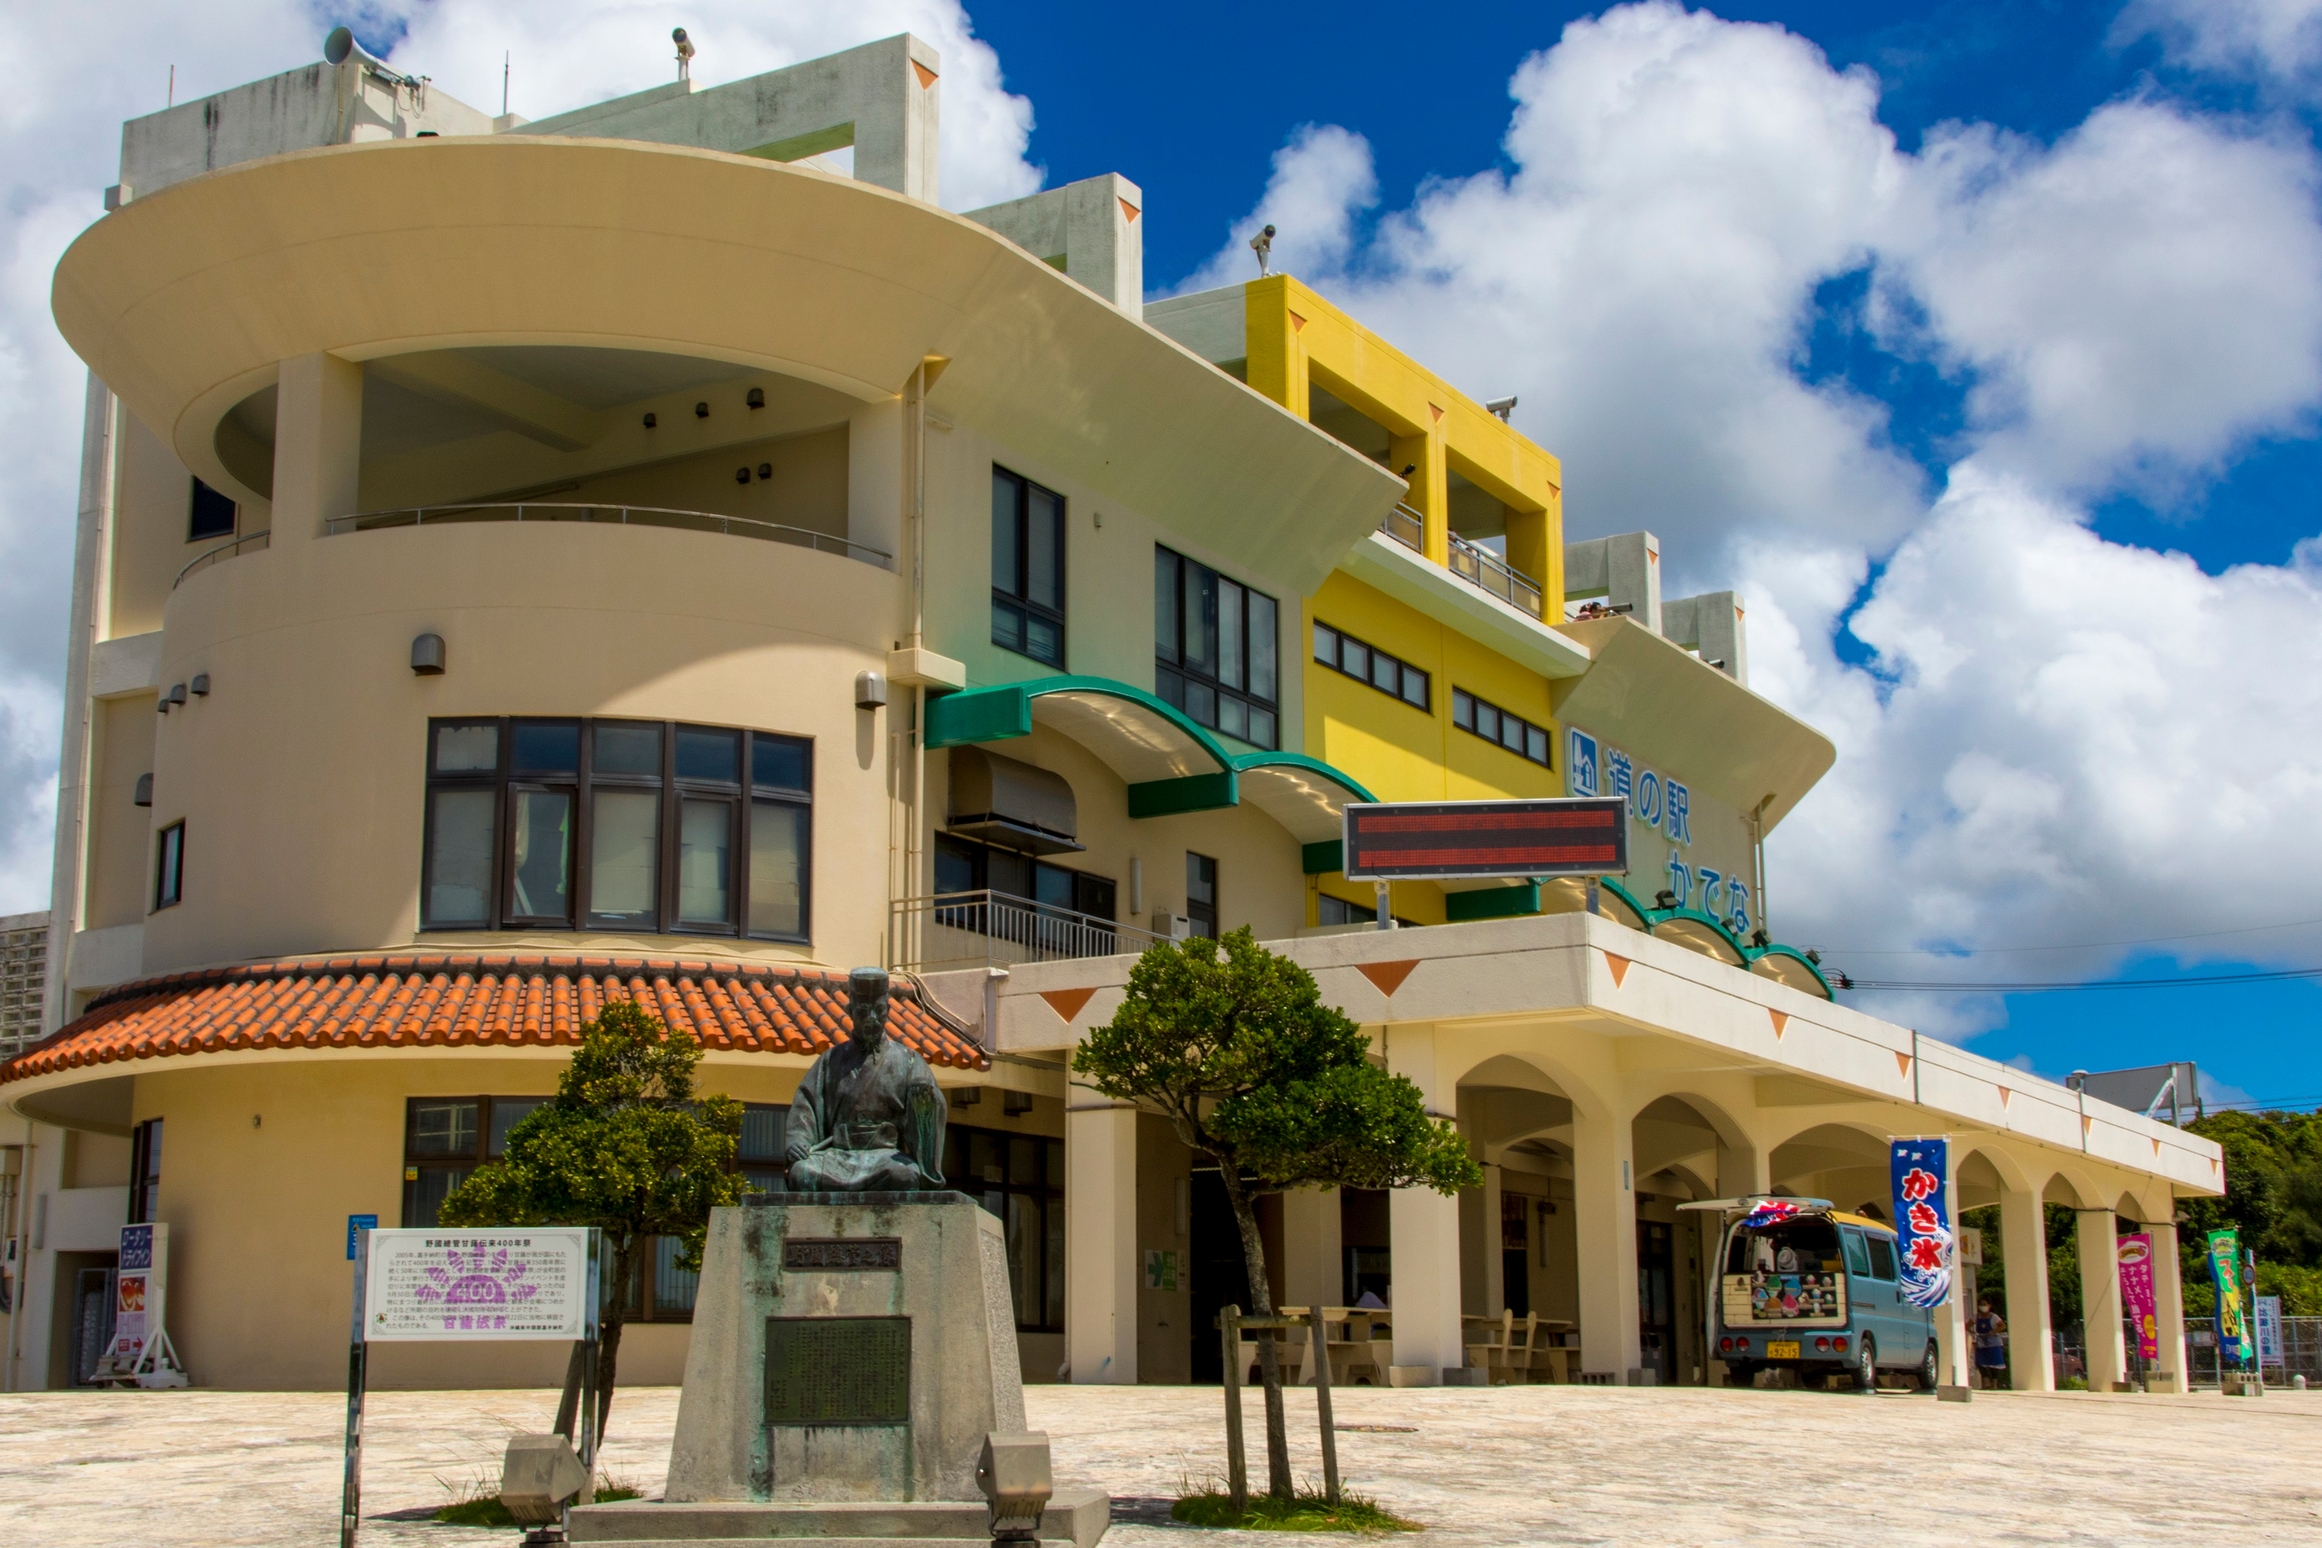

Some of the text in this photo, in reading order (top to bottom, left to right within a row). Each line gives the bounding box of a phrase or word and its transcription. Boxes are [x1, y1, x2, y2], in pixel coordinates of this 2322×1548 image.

[1605, 748, 1691, 847] 道の駅
[1666, 849, 1750, 934] かでな
[1902, 1167, 1942, 1271] かき氷
[122, 1229, 152, 1246] ロータリー
[121, 1248, 152, 1266] ドライブイン
[456, 1282, 496, 1300] 400
[1774, 1348, 1797, 1357] 92-15
